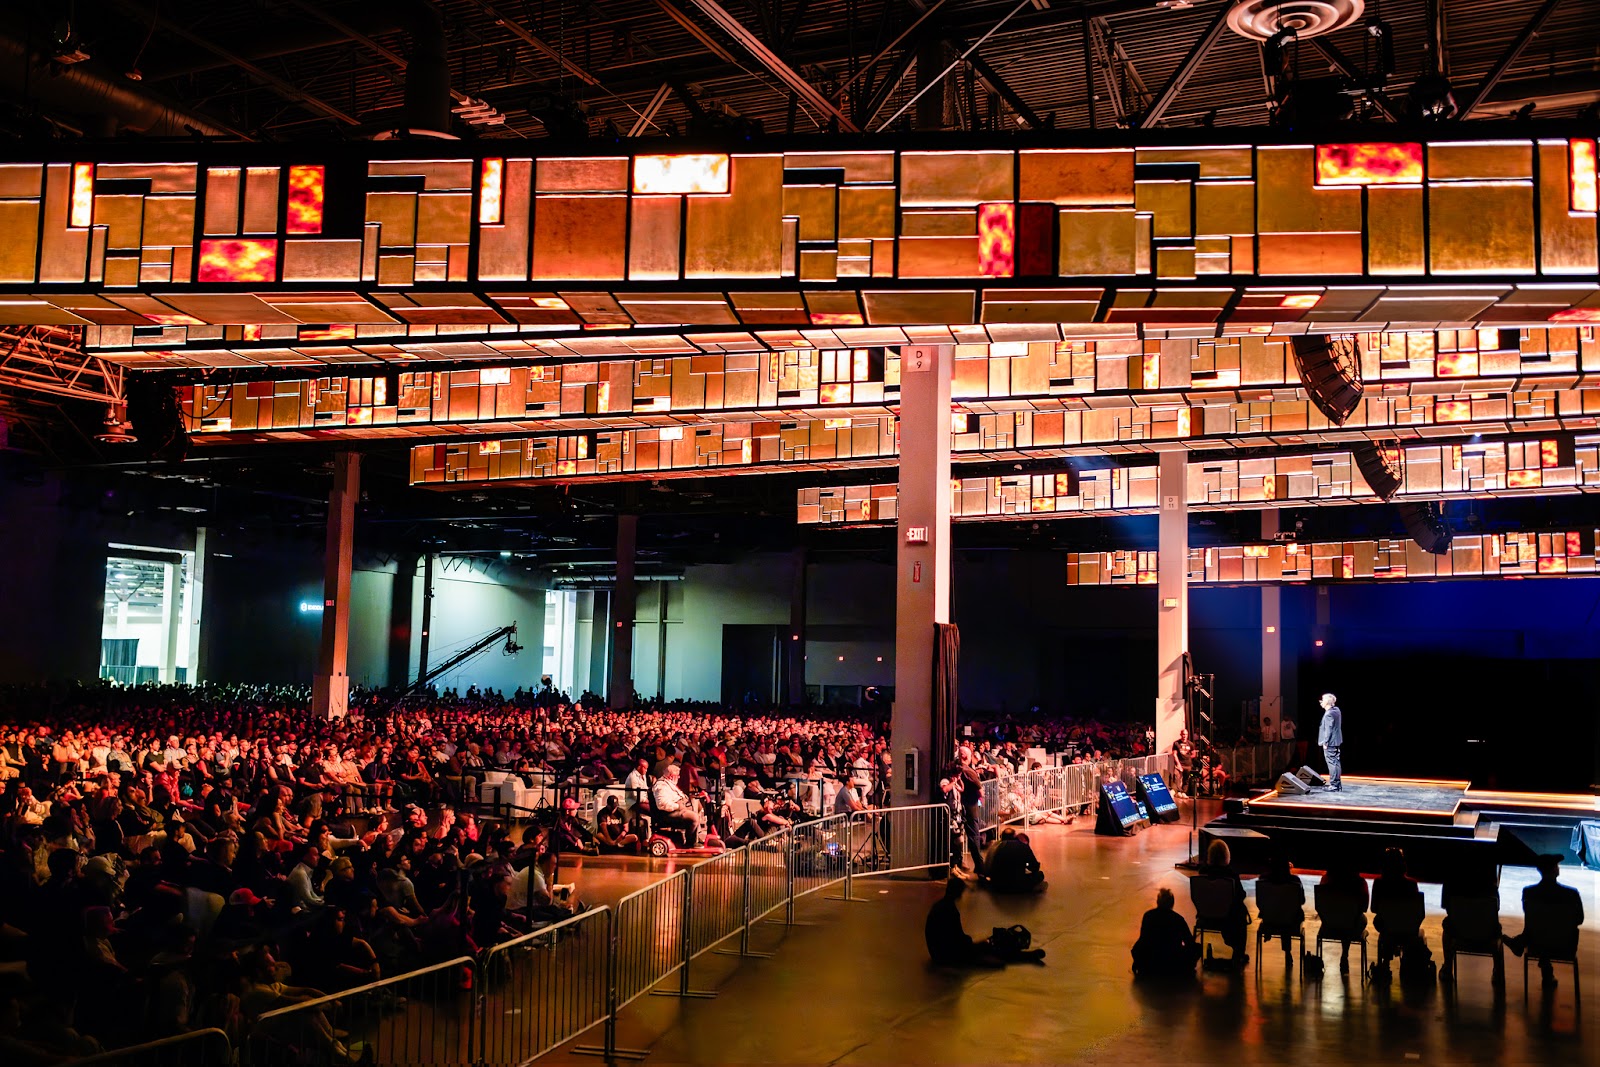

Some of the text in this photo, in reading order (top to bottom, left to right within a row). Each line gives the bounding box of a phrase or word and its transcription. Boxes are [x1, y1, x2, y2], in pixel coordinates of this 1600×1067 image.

[916, 350, 923, 359] D
[916, 361, 922, 369] 9
[908, 527, 925, 541] EXIT
